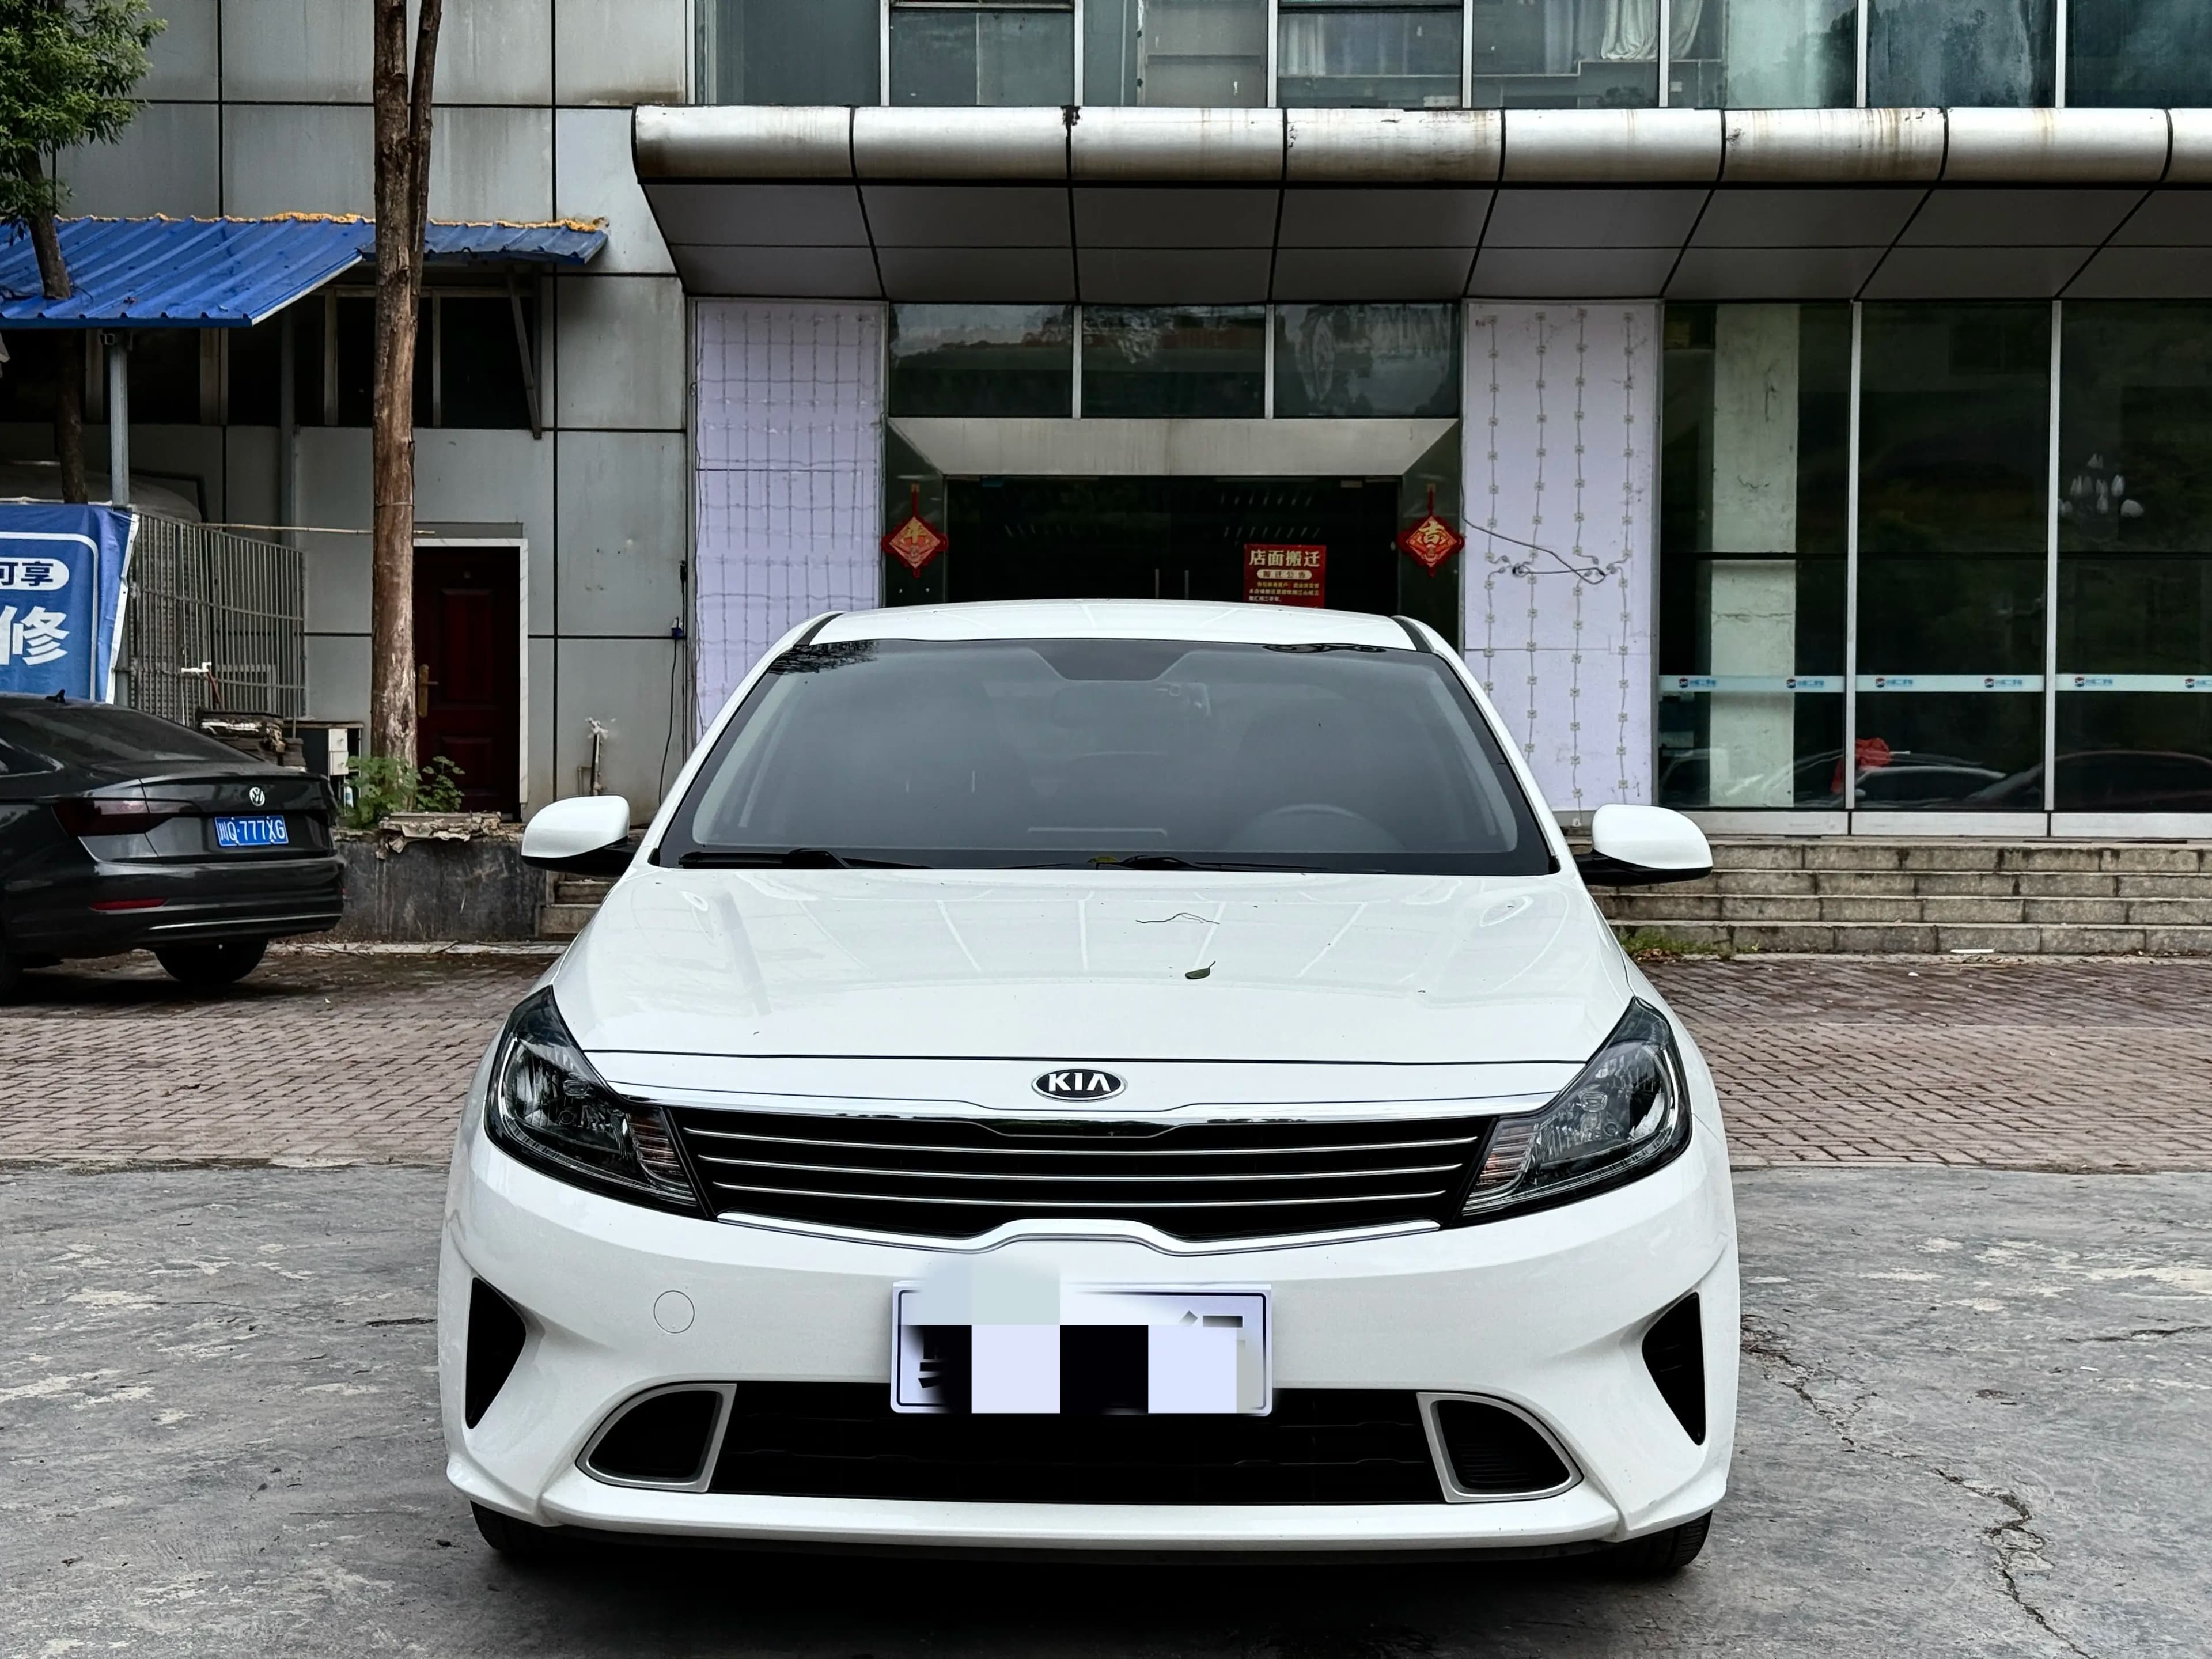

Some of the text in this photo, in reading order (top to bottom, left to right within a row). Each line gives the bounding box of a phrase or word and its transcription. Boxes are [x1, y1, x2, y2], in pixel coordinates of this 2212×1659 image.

[1249, 548, 1321, 567] 店面搬迁
[1048, 1072, 1111, 1092] KIA
